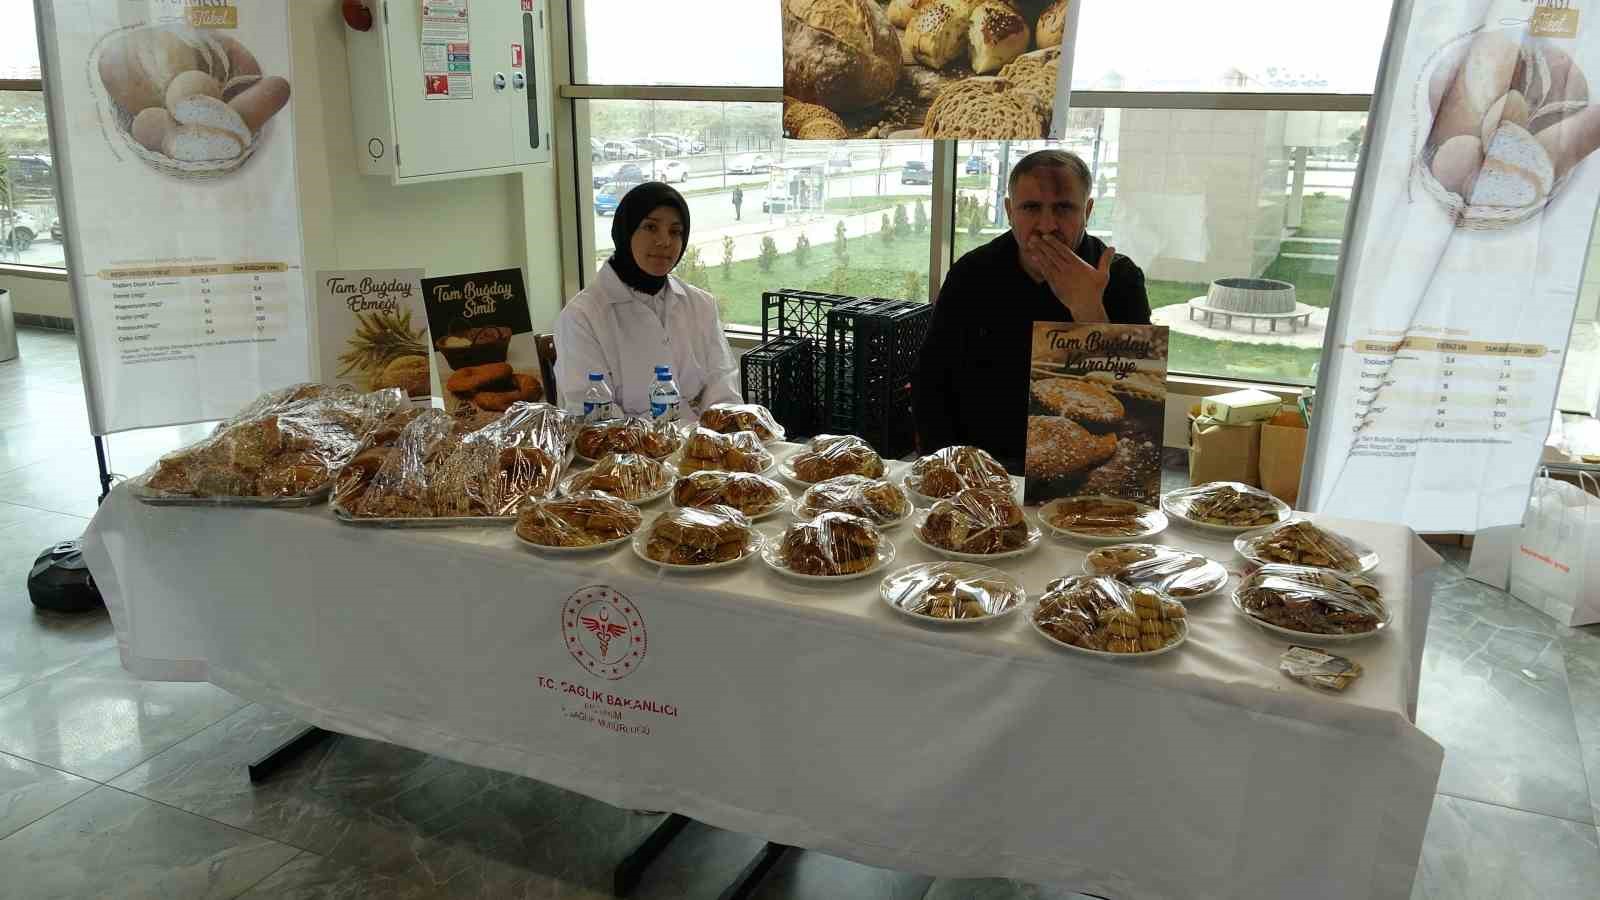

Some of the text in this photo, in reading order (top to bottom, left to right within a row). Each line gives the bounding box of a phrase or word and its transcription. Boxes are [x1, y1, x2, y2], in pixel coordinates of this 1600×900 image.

[326, 277, 358, 296] Tam
[433, 284, 463, 303] Tam
[1046, 329, 1081, 350] Tam
[537, 676, 557, 691] T.C.
